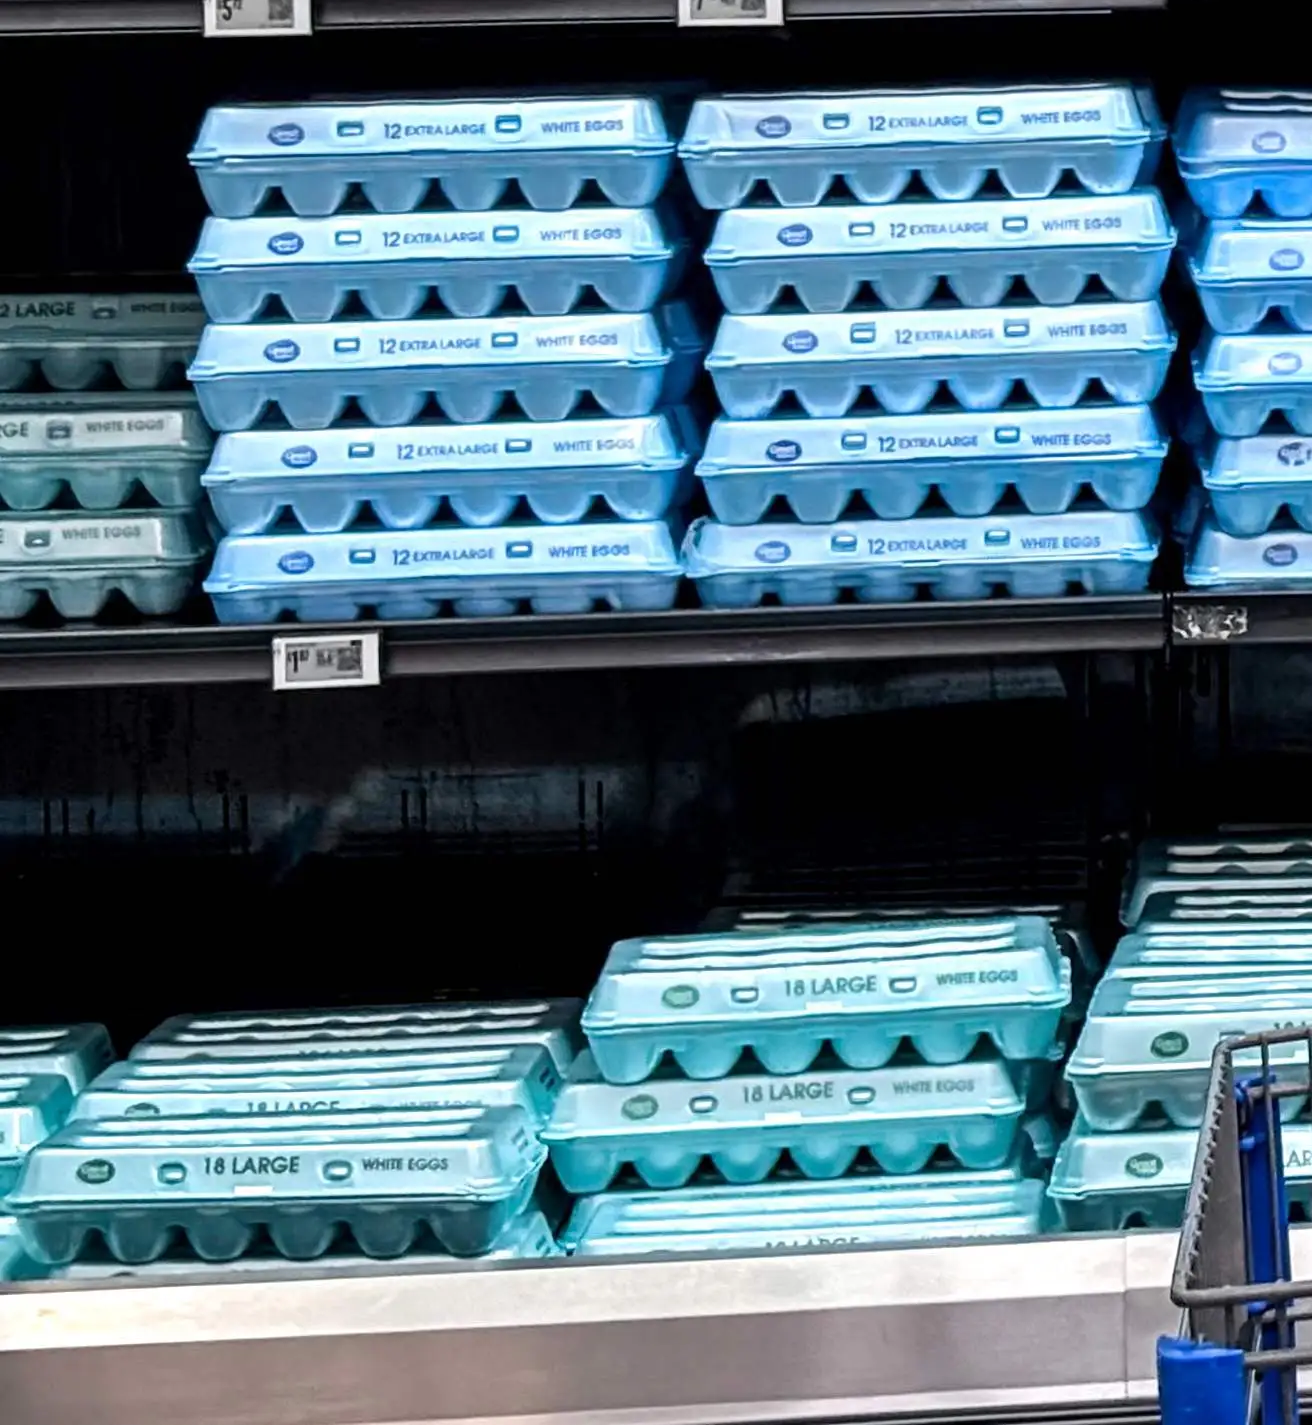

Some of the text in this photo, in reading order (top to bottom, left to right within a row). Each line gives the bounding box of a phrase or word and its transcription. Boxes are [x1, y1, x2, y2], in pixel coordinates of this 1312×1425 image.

[384, 118, 623, 139] 12 EXTRA LARGE WHITE EGGS
[86, 419, 165, 433] WHITE EGGS
[878, 433, 1112, 452] 12 EXTRA LARGE WHITE EGGS
[783, 970, 1018, 997] 18 LARGE WHITE EGGS
[742, 1079, 975, 1104] 18 LARGE WHITE EGGS
[203, 1155, 448, 1175] 18 LARGE WHITE EGGS
